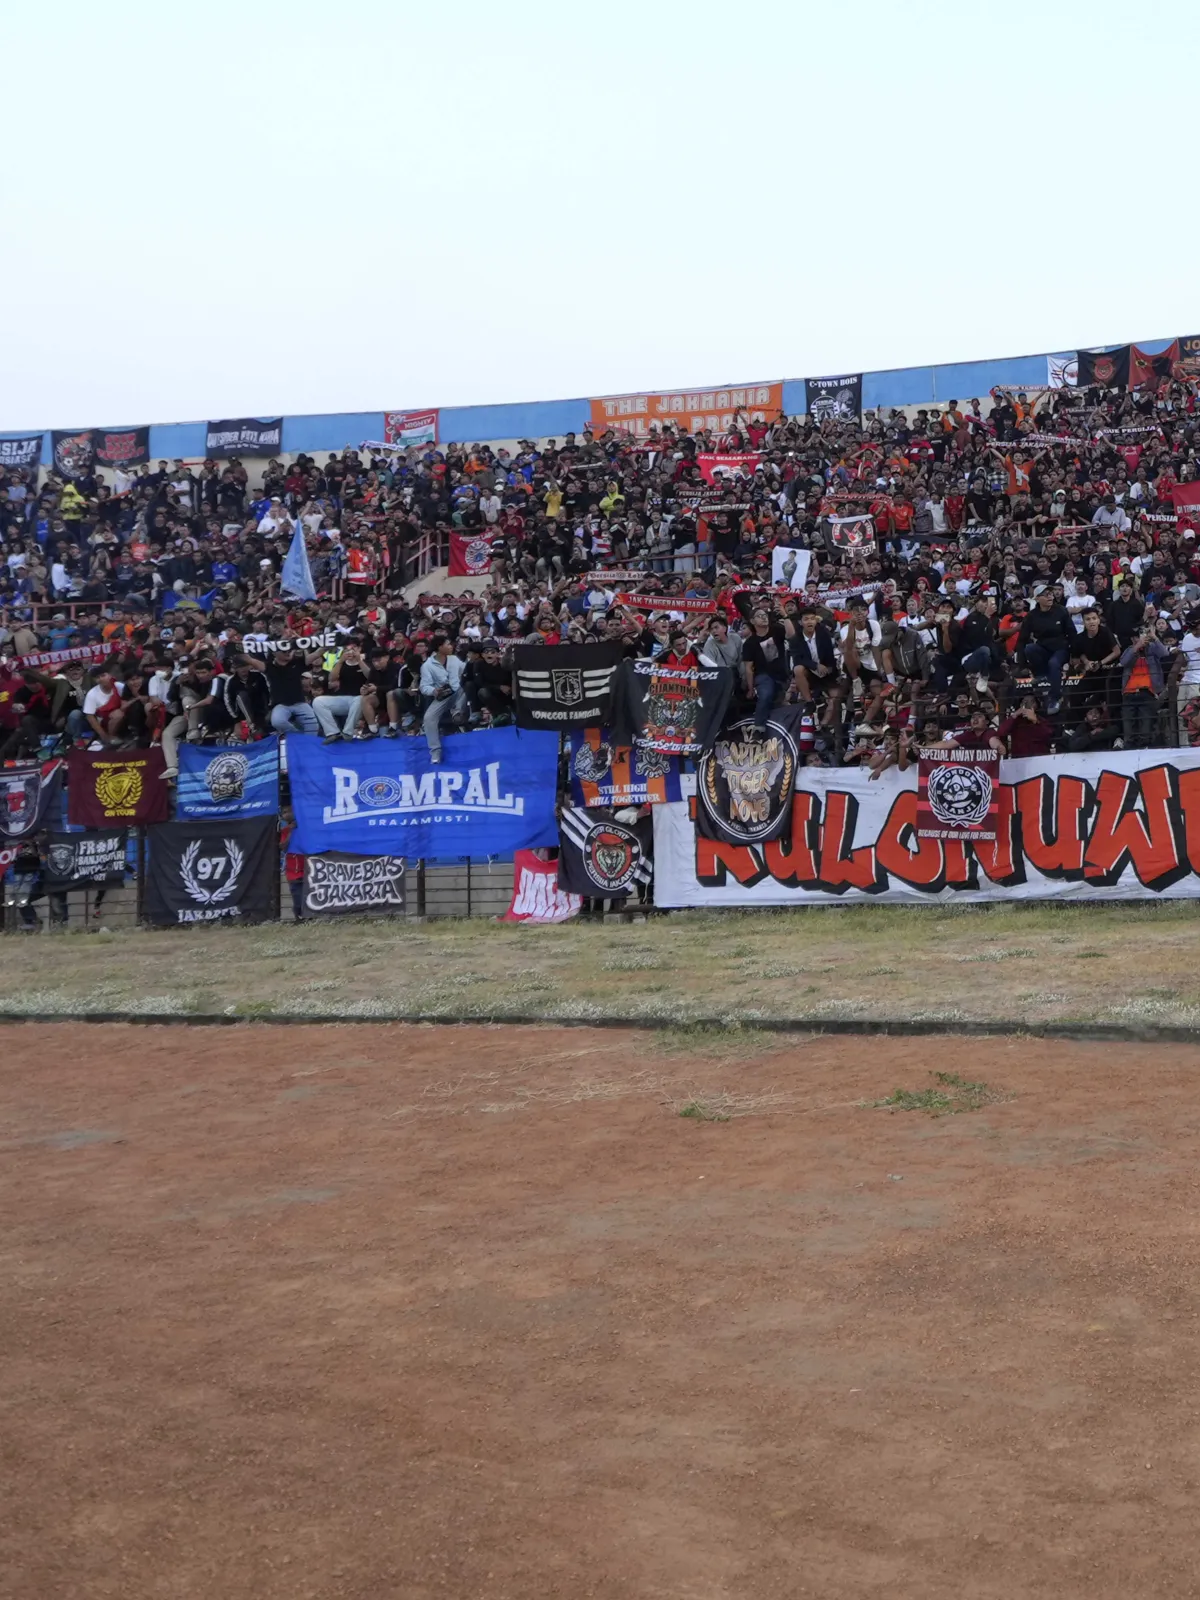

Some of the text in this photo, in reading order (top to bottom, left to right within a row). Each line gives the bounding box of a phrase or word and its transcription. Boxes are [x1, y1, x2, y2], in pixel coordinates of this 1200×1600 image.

[809, 376, 858, 388] C-TOWN BOIS
[602, 387, 770, 417] THE JAKMANIA
[0, 440, 38, 457] SIJA
[1146, 513, 1179, 522] PERSIJA
[628, 596, 711, 609] JAK TANGERANG BARAT
[242, 631, 336, 654] RING ONE
[715, 737, 783, 767] CAPTAIN
[920, 748, 998, 762] SPEZIAL AWAY DAYS
[725, 768, 772, 794] TIGER
[940, 769, 977, 784] PONDOK
[332, 761, 514, 816] ROMPAL
[598, 783, 647, 794] STILL HIGH
[589, 793, 660, 806] STILL TOGETHER
[117, 808, 137, 817] TOUR
[942, 802, 977, 814] RANJI
[368, 815, 471, 827] BRAJAMUSTI
[605, 826, 631, 839] GLORY
[918, 829, 940, 838] BECAUSE
[941, 830, 948, 838] OF
[948, 830, 958, 838] OUR
[197, 858, 226, 880] 97
[586, 859, 638, 888] PERSIJA JAKARTA
[307, 879, 403, 911] JAKARTA
